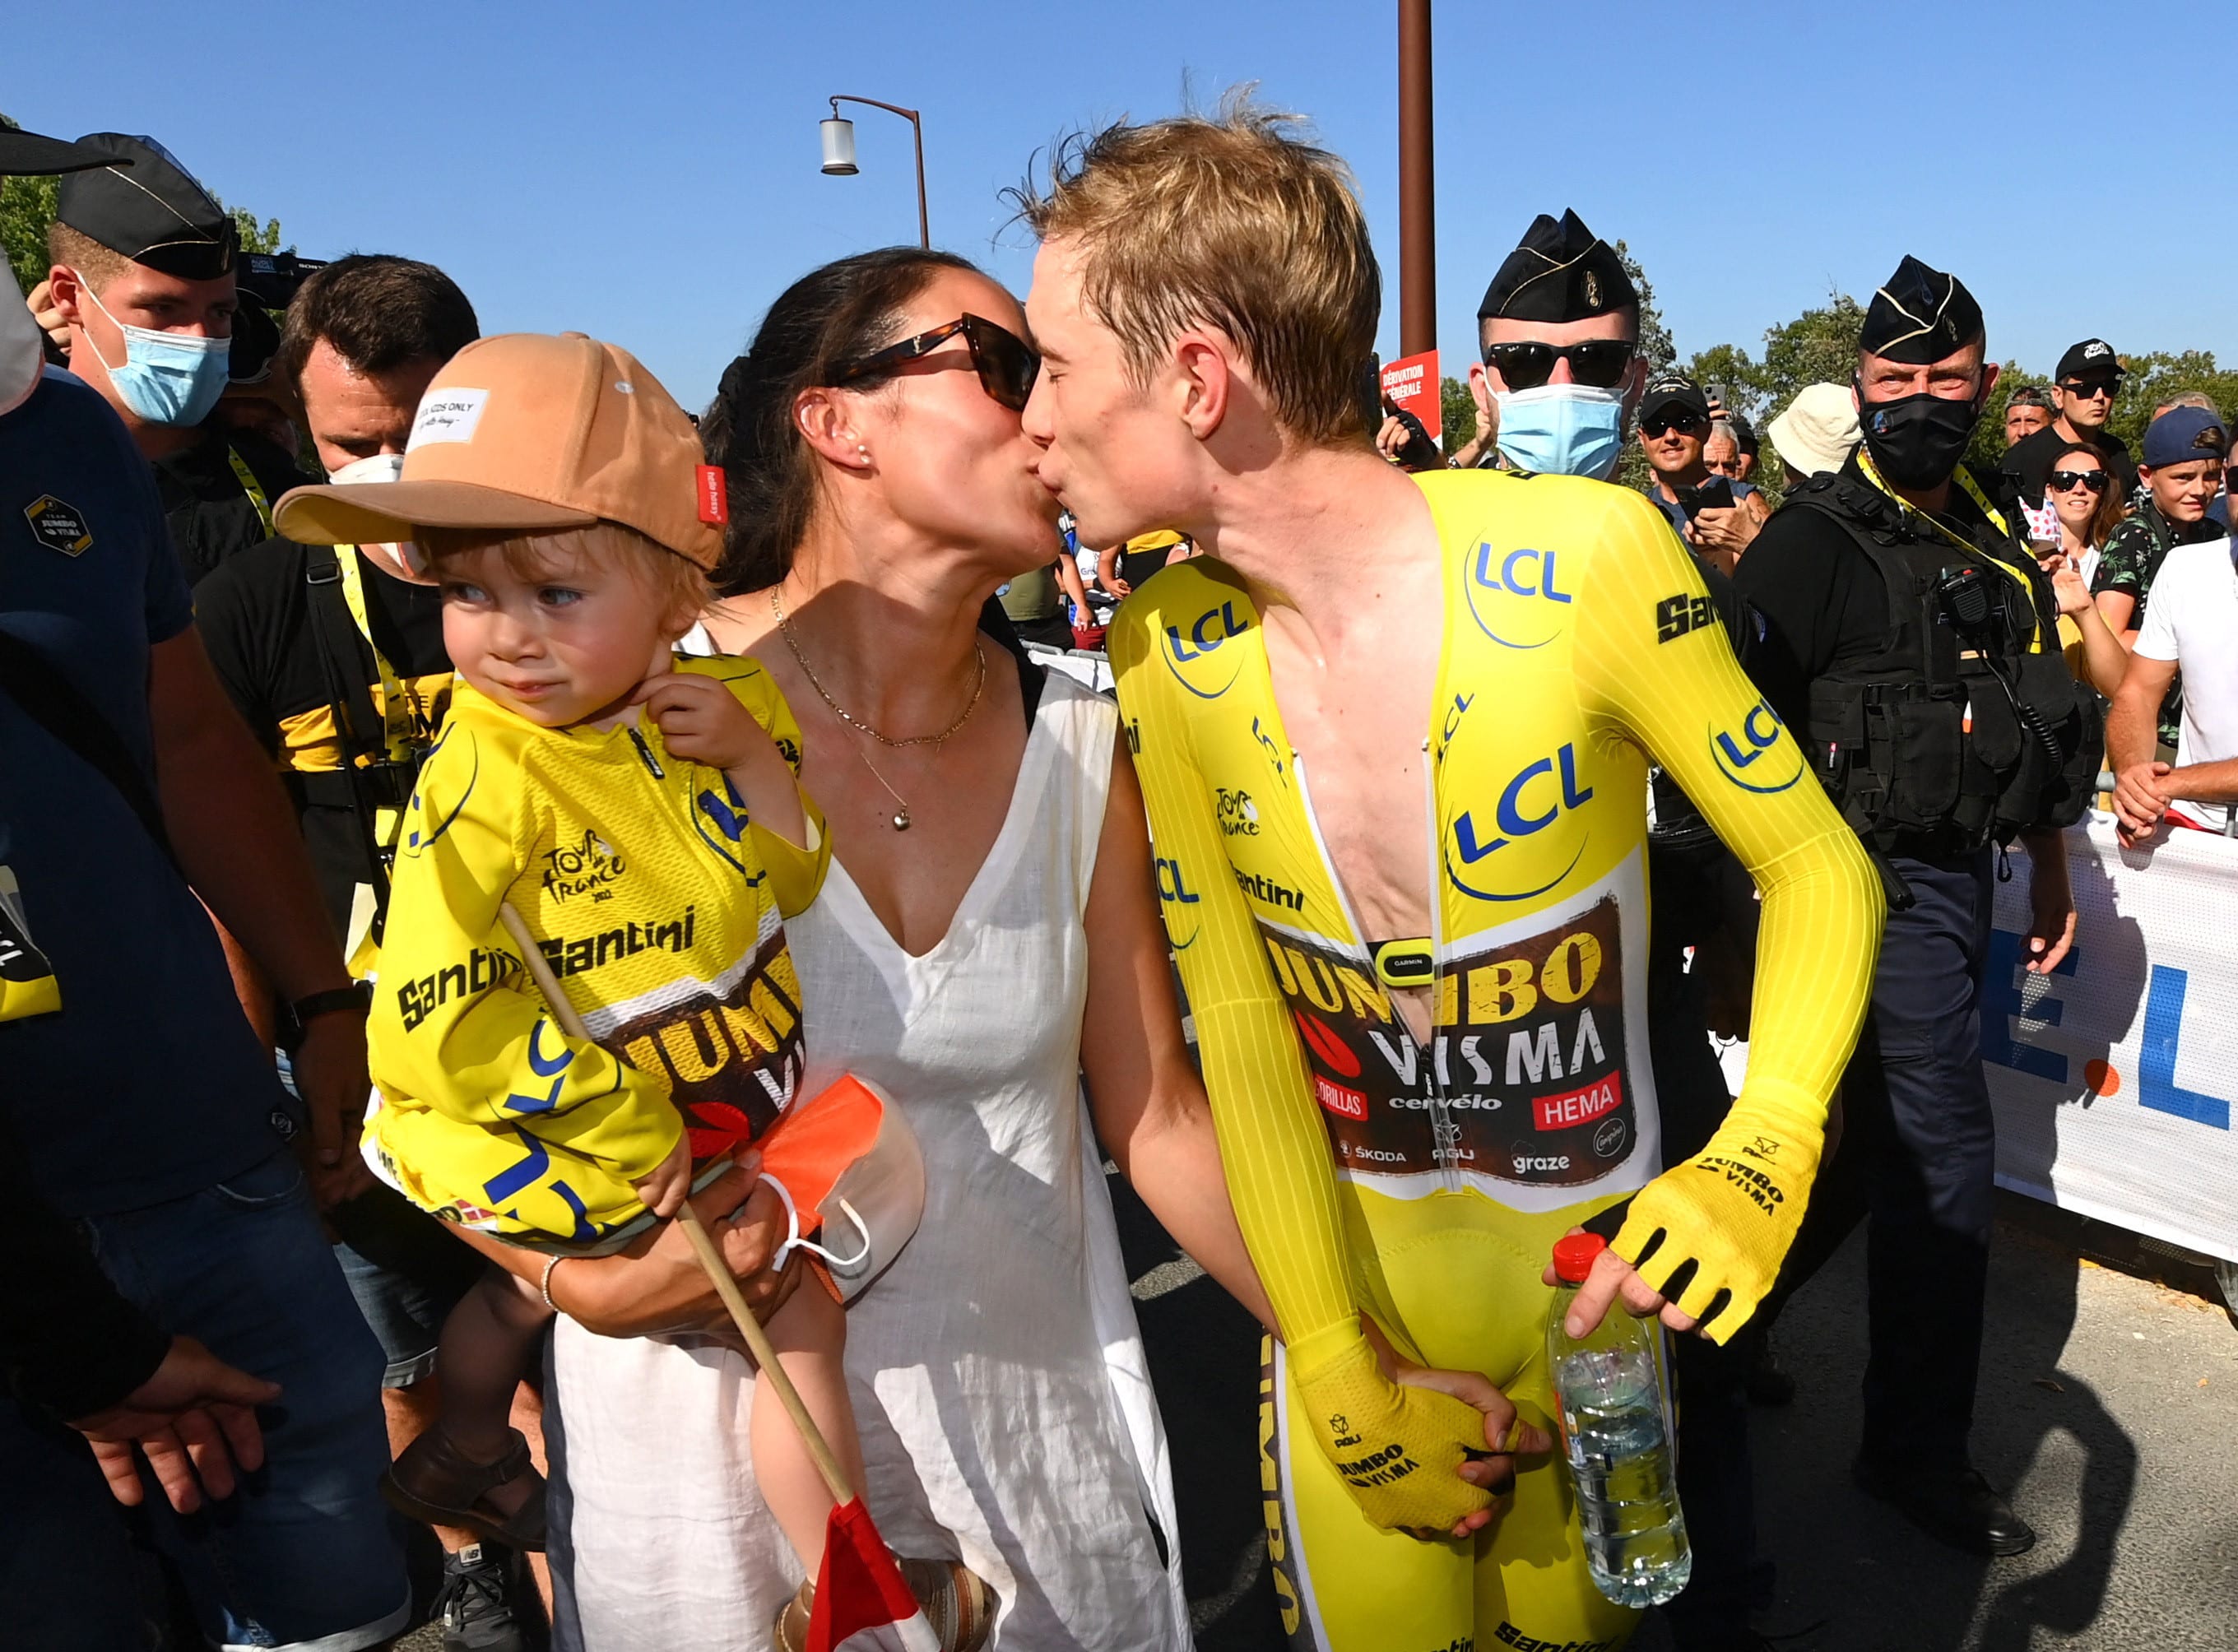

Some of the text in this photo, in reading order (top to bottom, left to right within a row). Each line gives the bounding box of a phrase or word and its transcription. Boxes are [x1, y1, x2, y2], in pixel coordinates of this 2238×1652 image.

[1382, 364, 1424, 387] DÉRIVATION
[448, 402, 475, 411] ONLY
[41, 519, 77, 528] JUMBO
[1475, 542, 1572, 604] LCL
[1166, 600, 1249, 663] LCL
[1453, 742, 1594, 865] LCL
[1155, 857, 1200, 904] CL
[1228, 857, 1304, 912] antini
[532, 905, 695, 986] Santini
[1394, 958, 1423, 967] GARMIN
[1367, 1006, 1606, 1086] VISMA
[1389, 1093, 1503, 1111] cervélo
[1544, 1083, 1614, 1125] HEMA
[1512, 1155, 1571, 1175] graze
[1701, 1156, 1785, 1204] JUMBO
[1725, 1169, 1776, 1217] VISMA
[1335, 1443, 1404, 1476] JUMBO
[1366, 1458, 1421, 1487] VISMA
